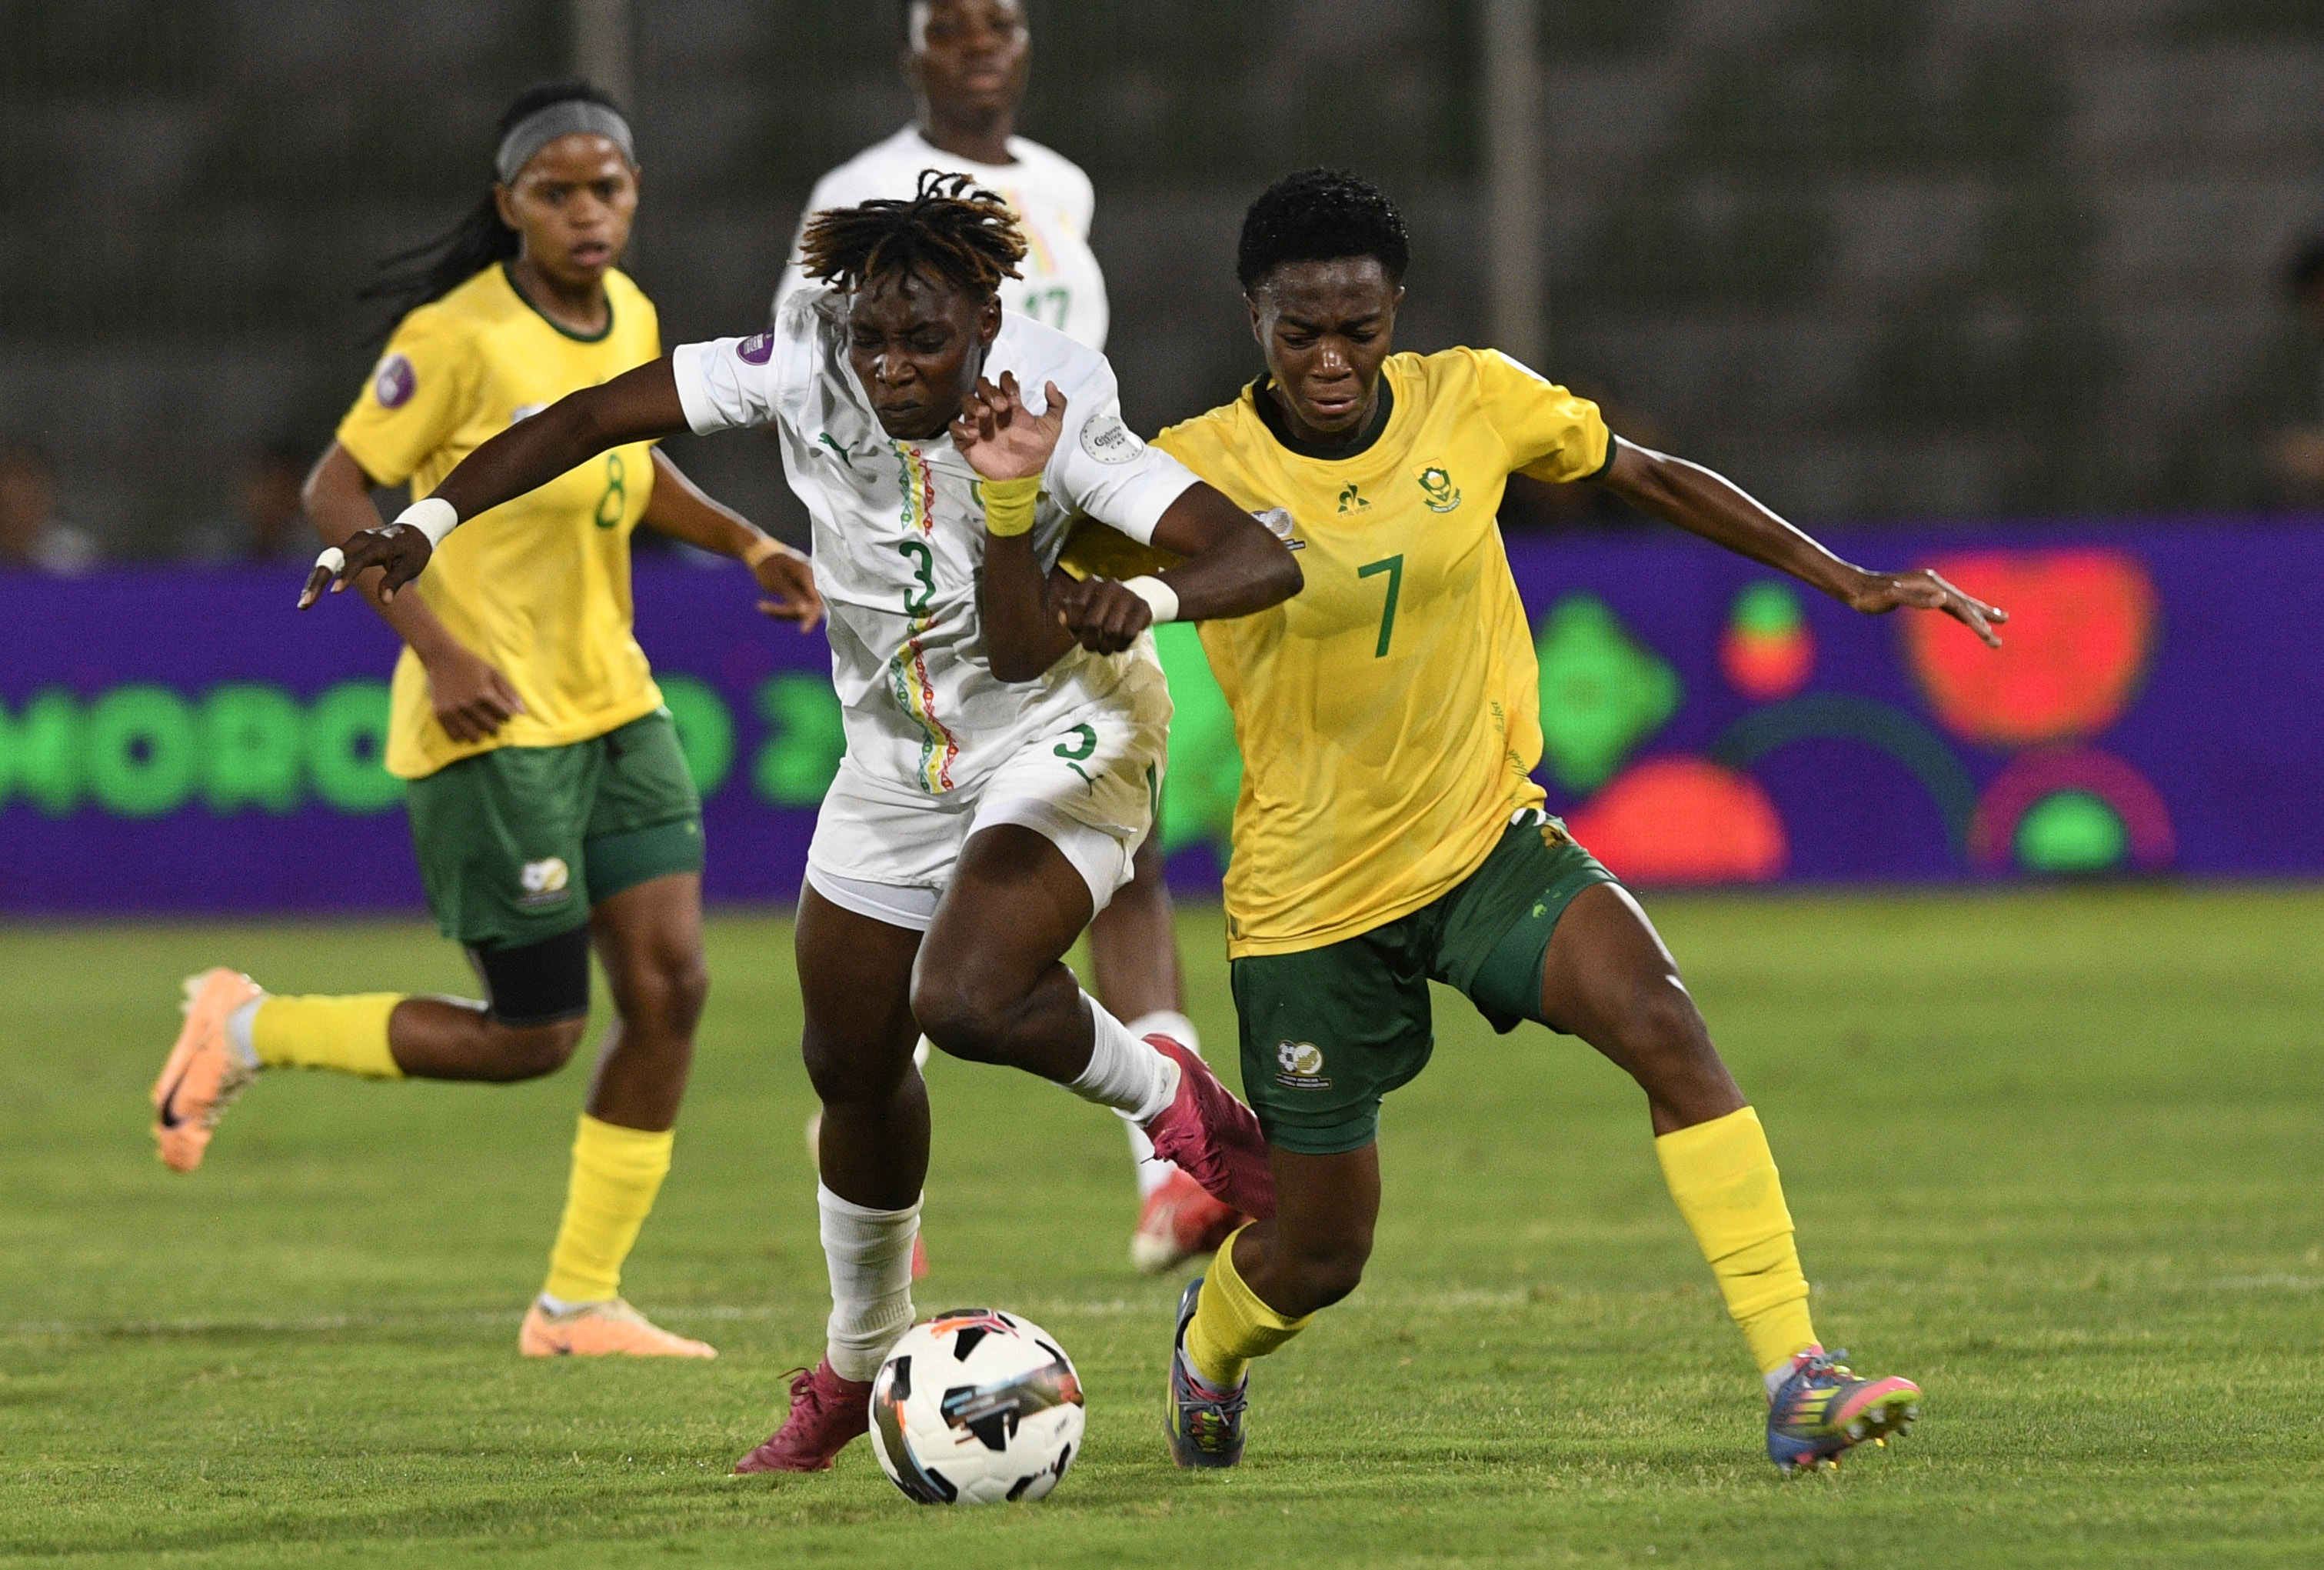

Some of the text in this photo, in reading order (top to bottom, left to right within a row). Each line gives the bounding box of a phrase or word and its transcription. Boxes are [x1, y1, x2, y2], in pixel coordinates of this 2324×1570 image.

[595, 453, 625, 528] 8
[898, 541, 937, 618] 3
[1357, 554, 1403, 658] 7
